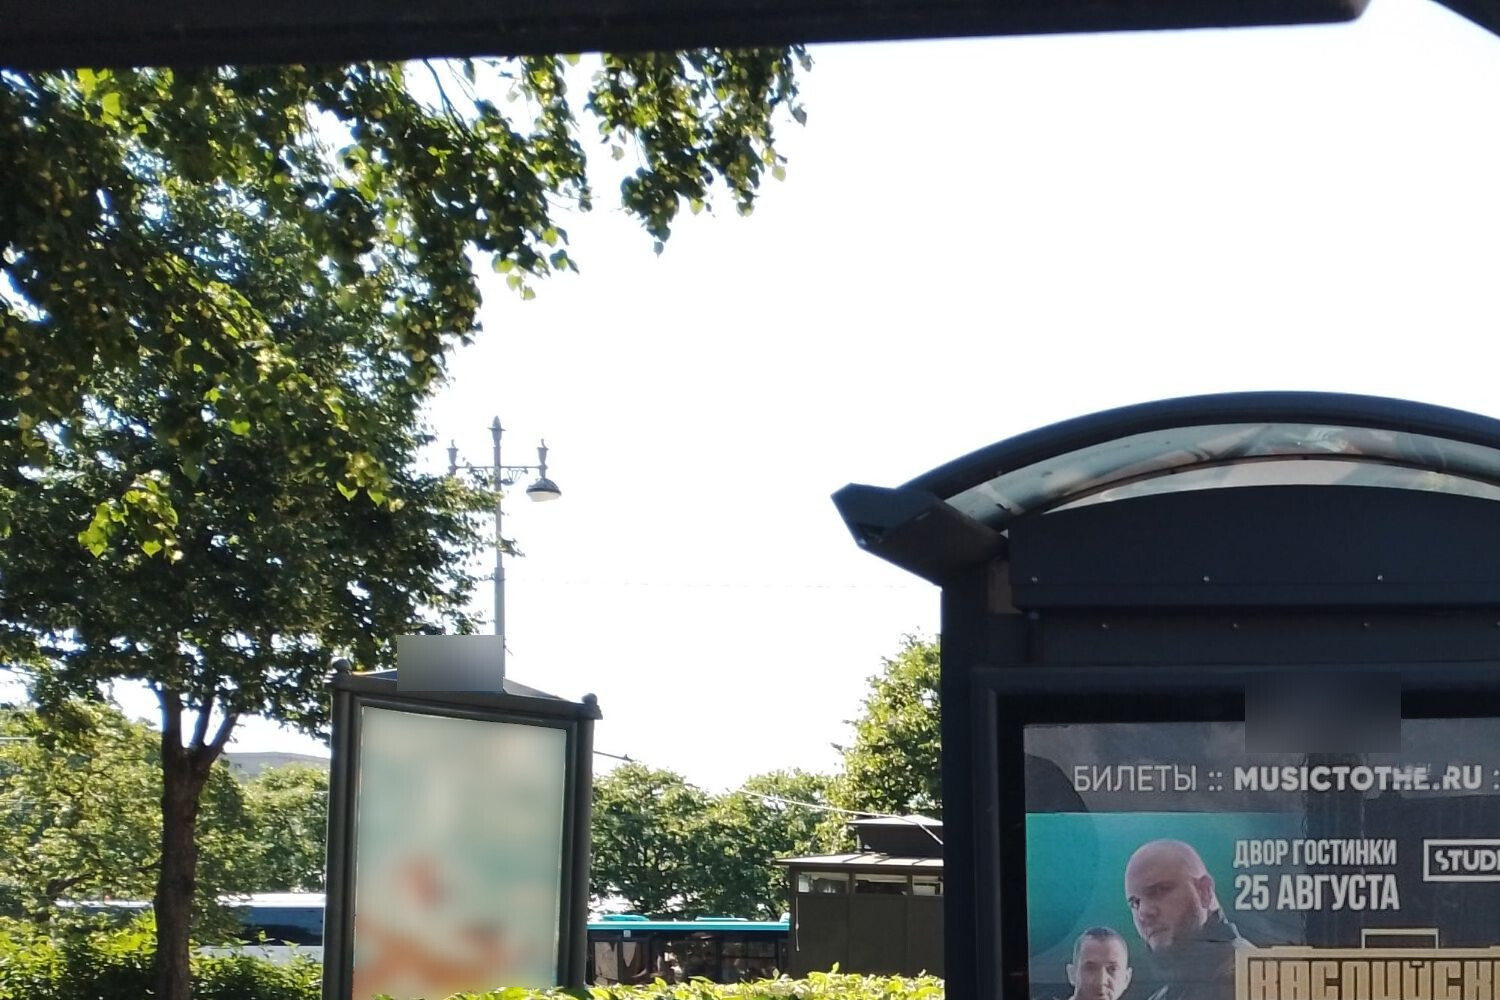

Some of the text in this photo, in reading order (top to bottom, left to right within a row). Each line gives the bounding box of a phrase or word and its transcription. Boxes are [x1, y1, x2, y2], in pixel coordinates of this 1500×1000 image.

[1073, 765, 1197, 792] БИЛЕТЫ
[1234, 764, 1482, 792] MUSICTOTHE.RU
[1233, 839, 1397, 868] ДВОР ГОСТИНКИ
[1234, 873, 1400, 911] 25 АВГУСТА
